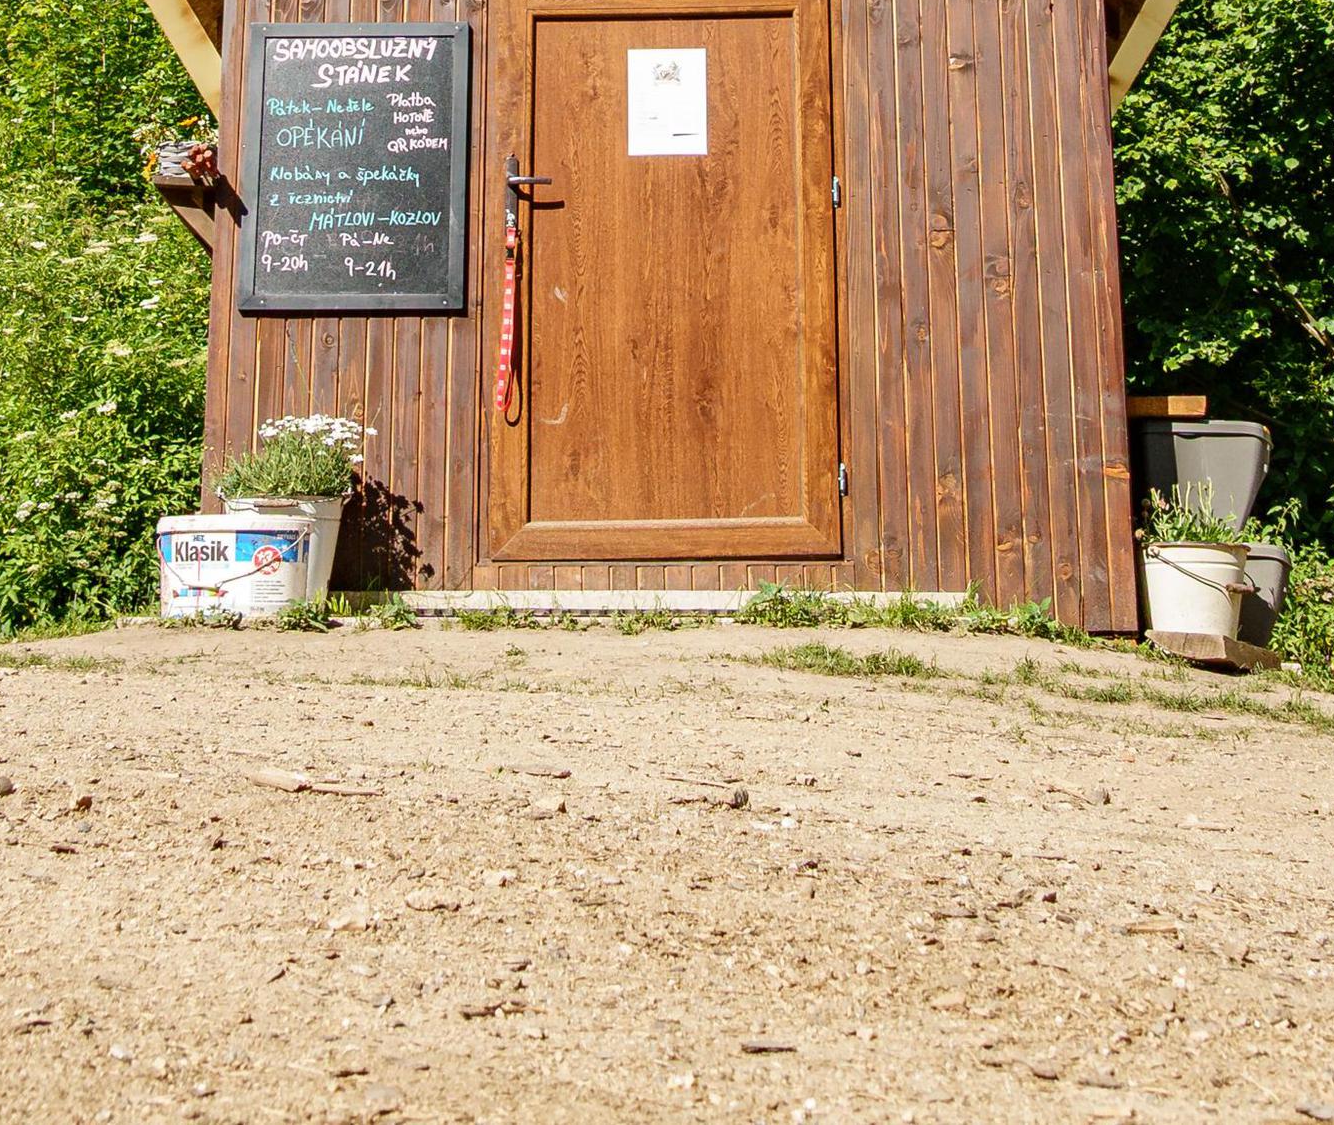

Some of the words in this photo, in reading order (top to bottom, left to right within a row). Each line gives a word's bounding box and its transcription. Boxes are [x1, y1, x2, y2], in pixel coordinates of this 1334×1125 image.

[273, 37, 438, 62] SAMOOBSLUŽNÝ
[310, 60, 412, 89] STÁNEK
[326, 98, 375, 114] Neděle
[386, 91, 436, 107] Platba
[393, 108, 435, 124] HOTOVĚ
[404, 125, 428, 136] nebo
[387, 137, 409, 153] QR
[409, 135, 448, 151] KÓDEM
[338, 171, 352, 180] a
[356, 165, 421, 187] špekáčky
[344, 257, 397, 281] 9-21h
[175, 541, 229, 562] Klasik
